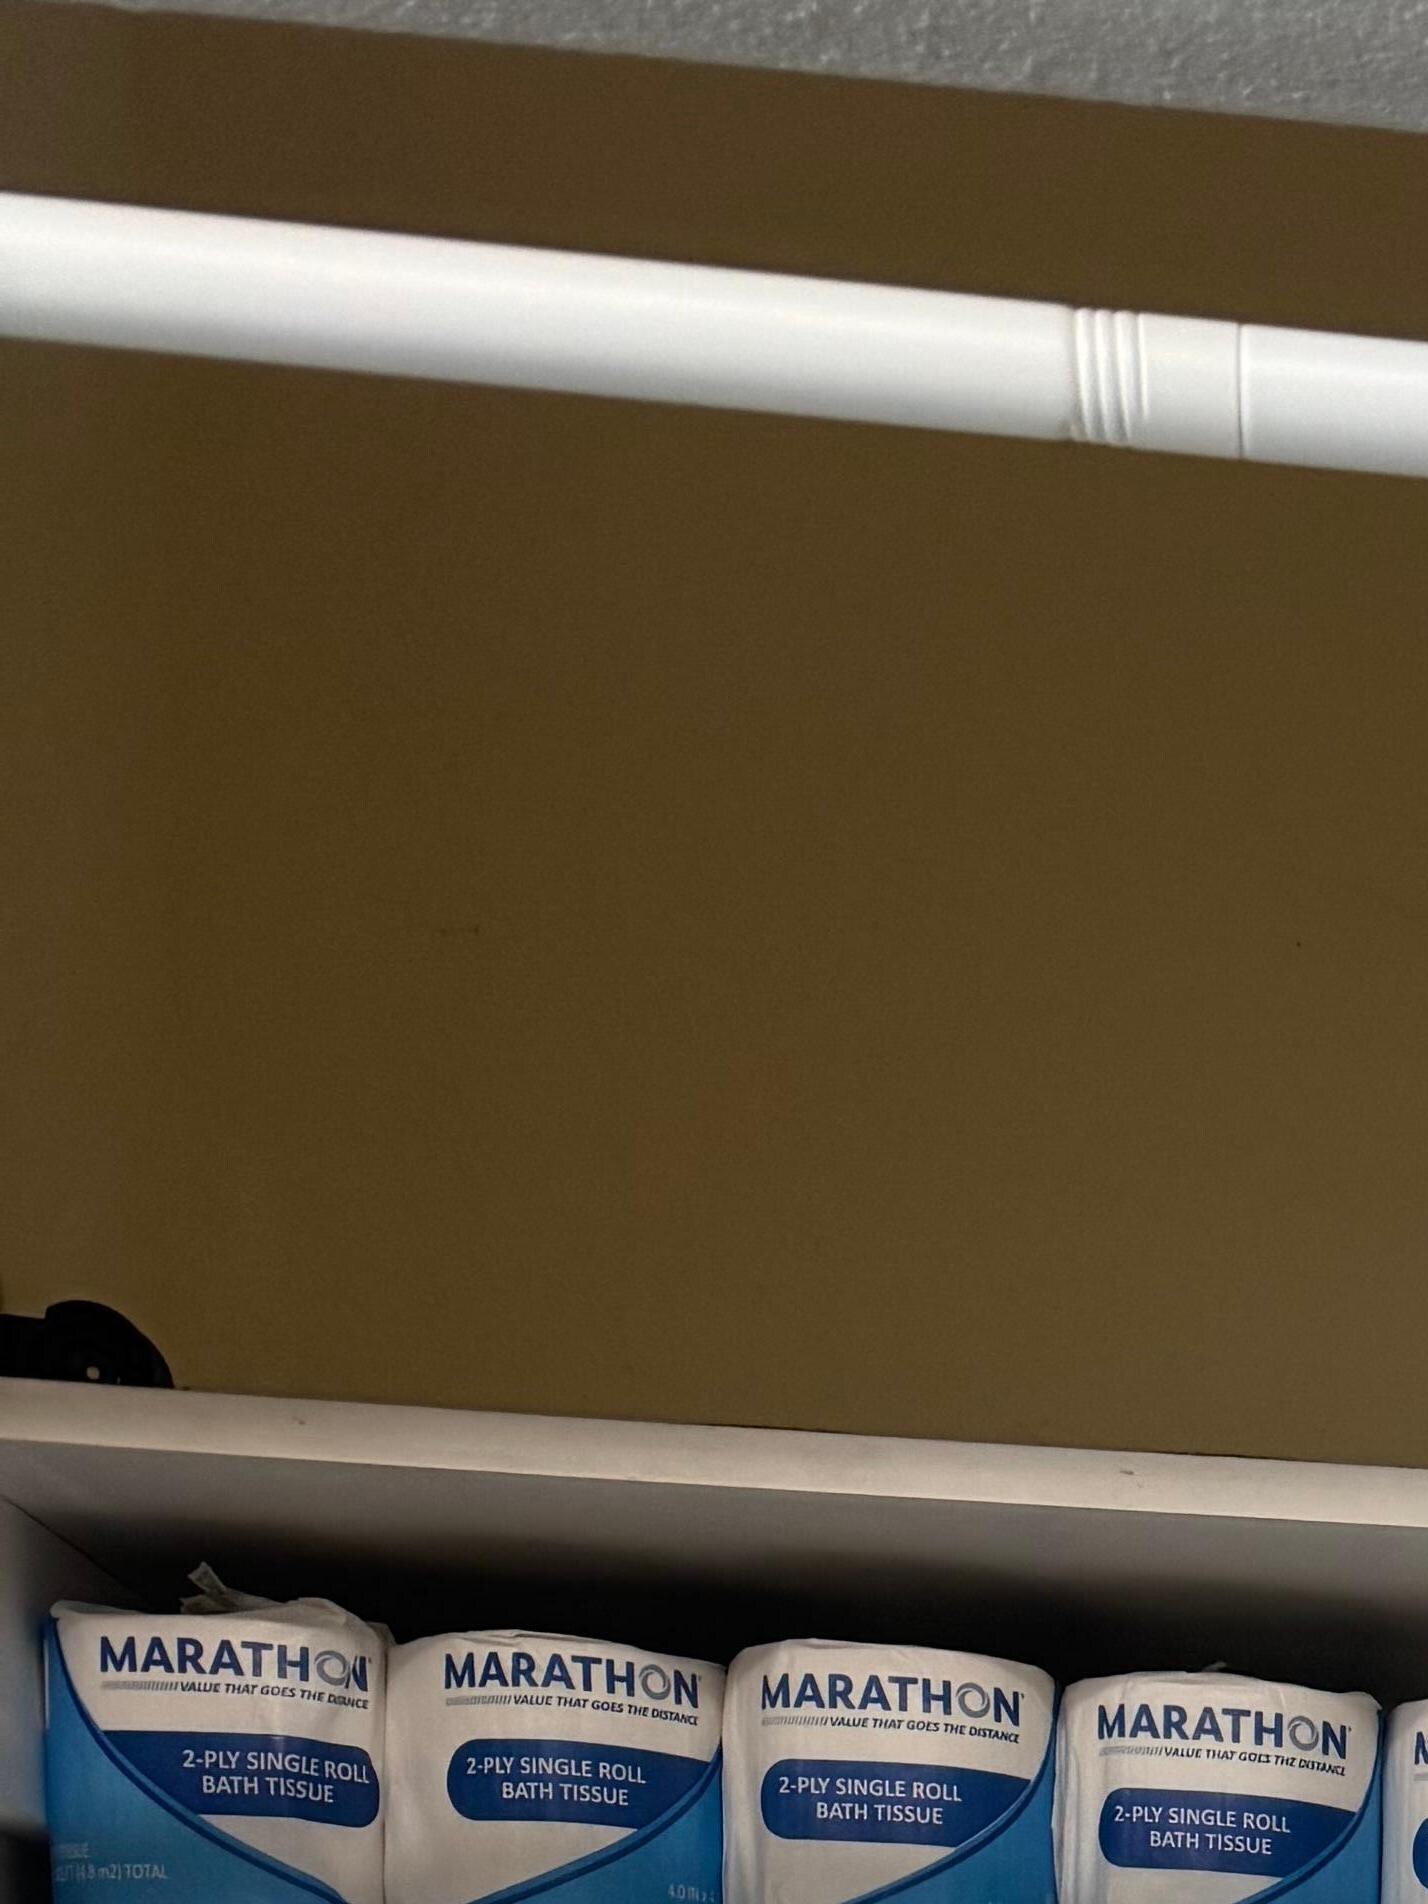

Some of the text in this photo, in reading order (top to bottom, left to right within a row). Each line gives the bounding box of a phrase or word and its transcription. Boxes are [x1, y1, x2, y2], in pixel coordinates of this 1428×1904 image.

[100, 1636, 369, 1692] MARATHON
[444, 1651, 699, 1709] MARATHON
[761, 1674, 1020, 1726] MARATHON
[1098, 1704, 1347, 1759] MARATHON
[466, 1757, 646, 1784] 2-PLY SINGLE ROLL
[502, 1783, 628, 1805] BATH TISSUE
